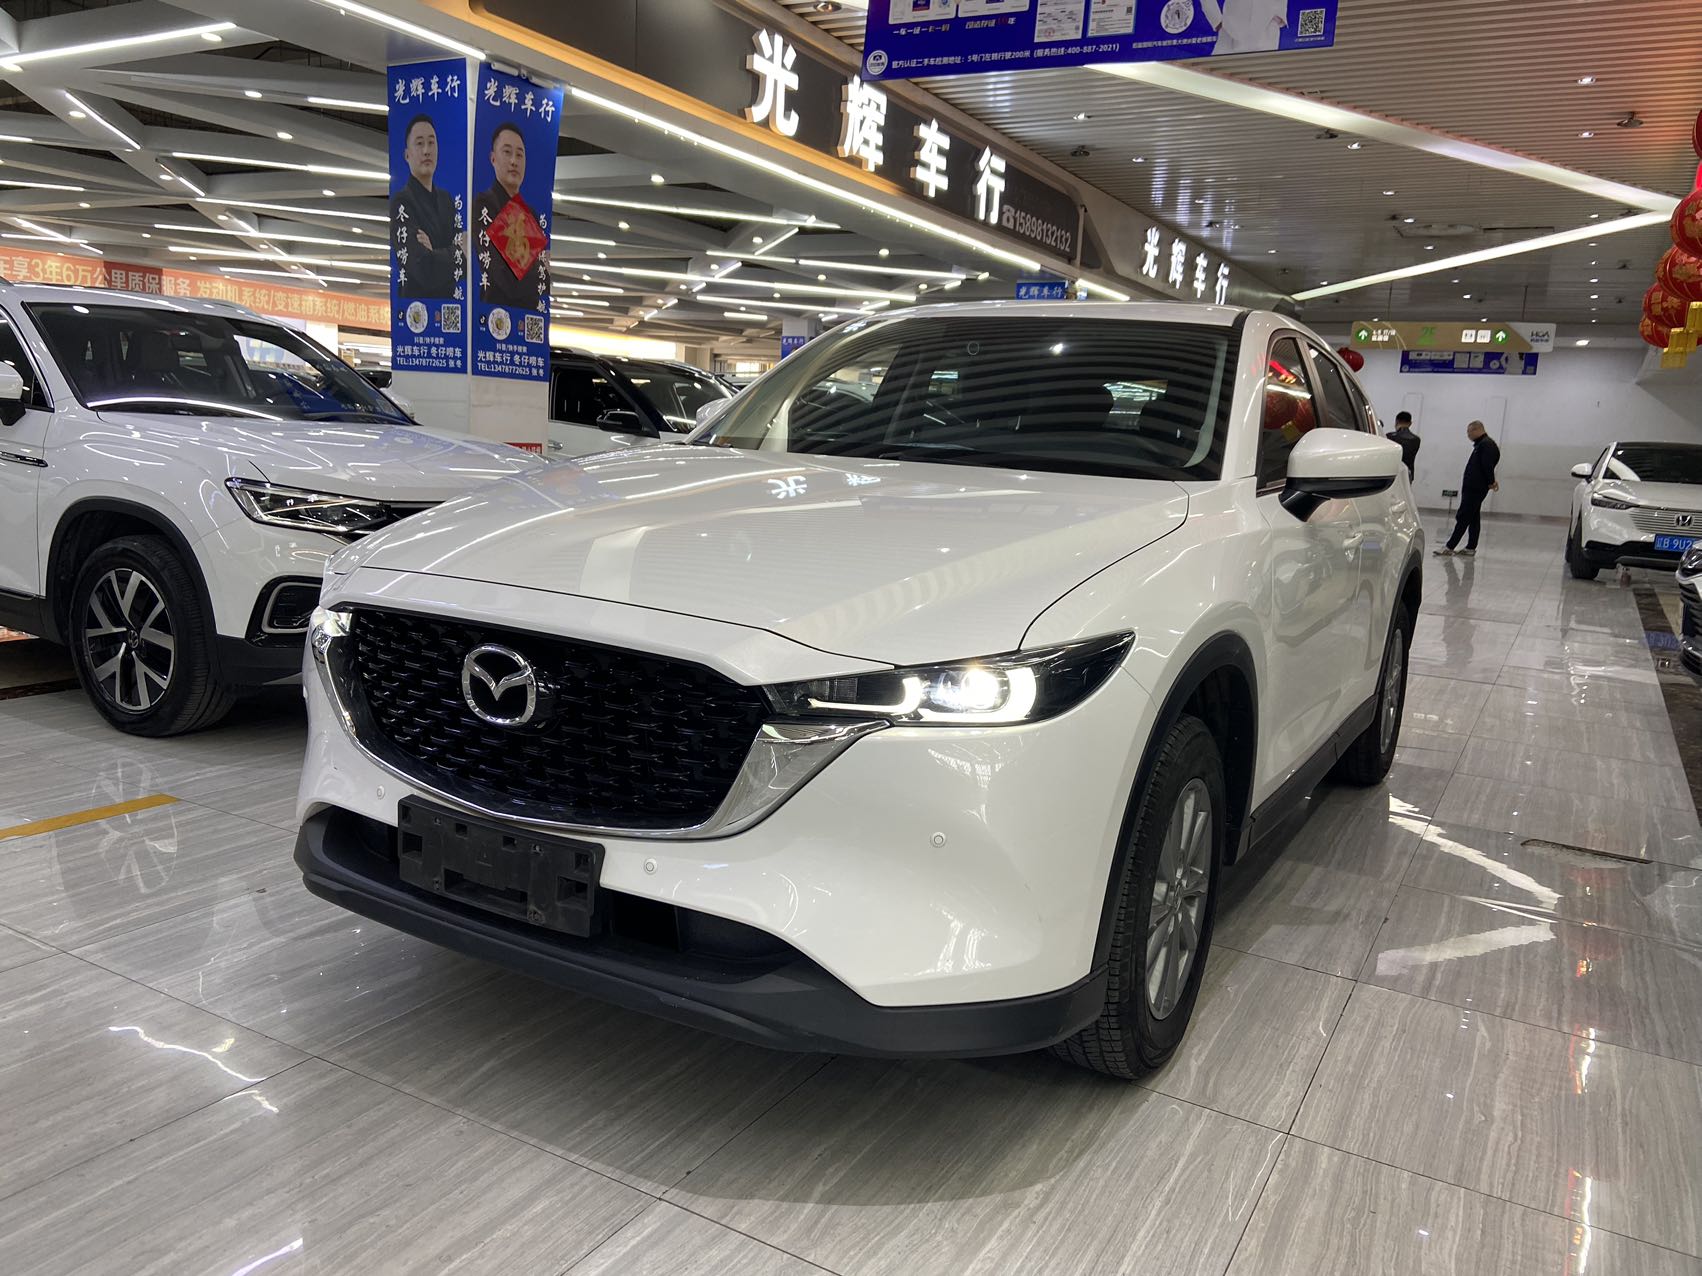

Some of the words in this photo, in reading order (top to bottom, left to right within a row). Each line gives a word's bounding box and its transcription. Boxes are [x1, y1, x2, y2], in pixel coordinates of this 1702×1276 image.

[394, 74, 460, 104] 光辉车行
[484, 77, 555, 123] 光辉车行
[746, 28, 1007, 225] 光辉车行
[453, 193, 465, 301] 为您保驾护航
[1015, 209, 1072, 252] 15898132132
[1141, 226, 1230, 306] 光辉车行
[396, 345, 428, 357] 光辉车行
[477, 350, 511, 364] 光辉车行
